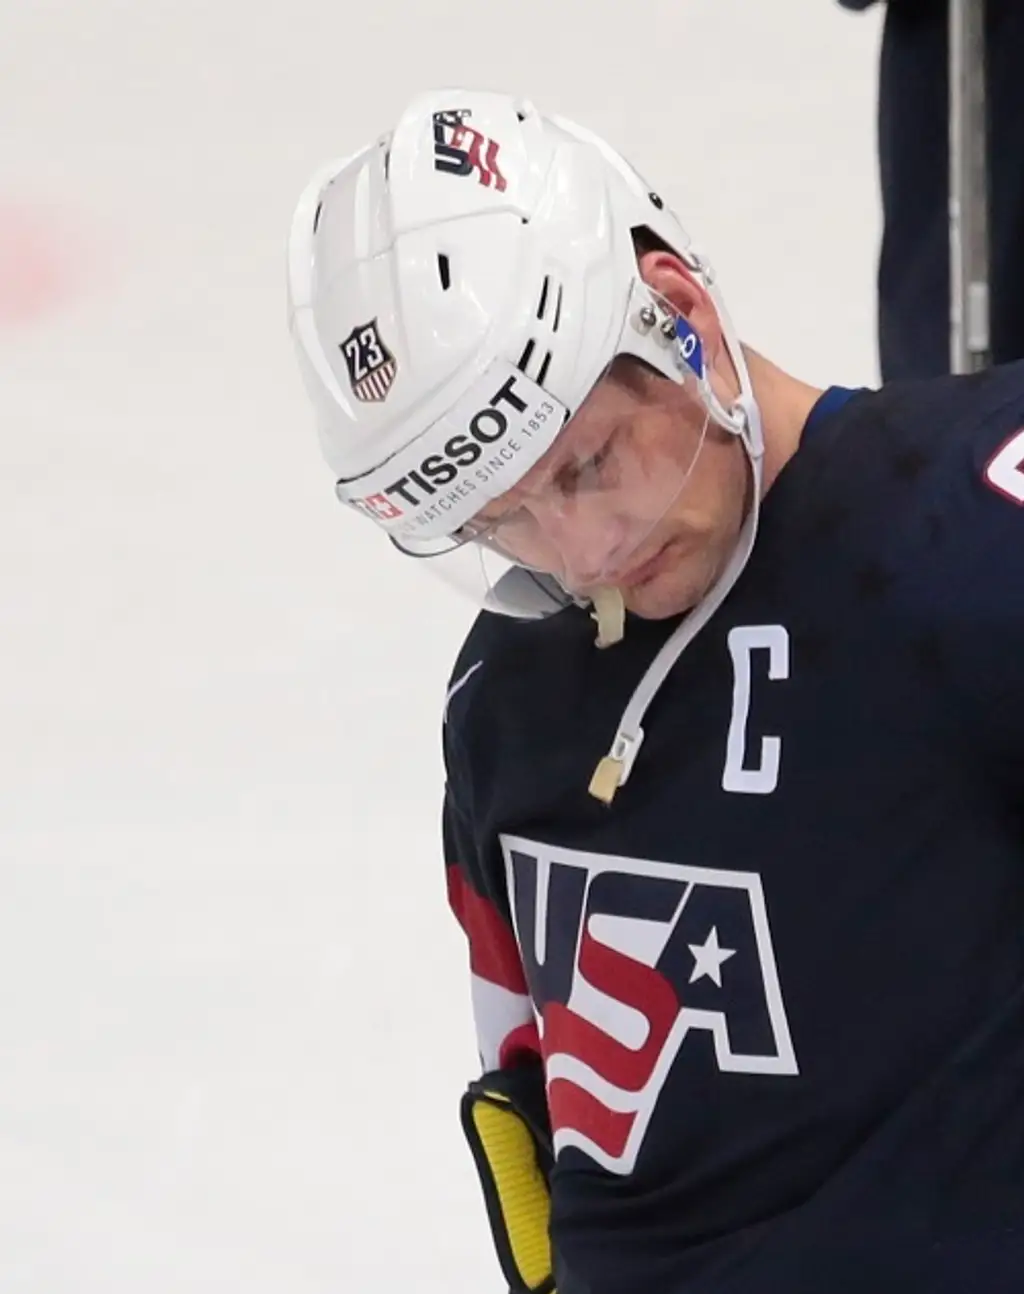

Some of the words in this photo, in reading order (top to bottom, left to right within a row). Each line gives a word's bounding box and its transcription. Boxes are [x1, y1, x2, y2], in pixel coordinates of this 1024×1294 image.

[345, 327, 385, 380] 23
[384, 375, 529, 508] TISSOT
[475, 439, 522, 482] SINCE
[521, 401, 556, 438] 1853
[721, 624, 790, 794] C
[499, 833, 799, 1176] USA
